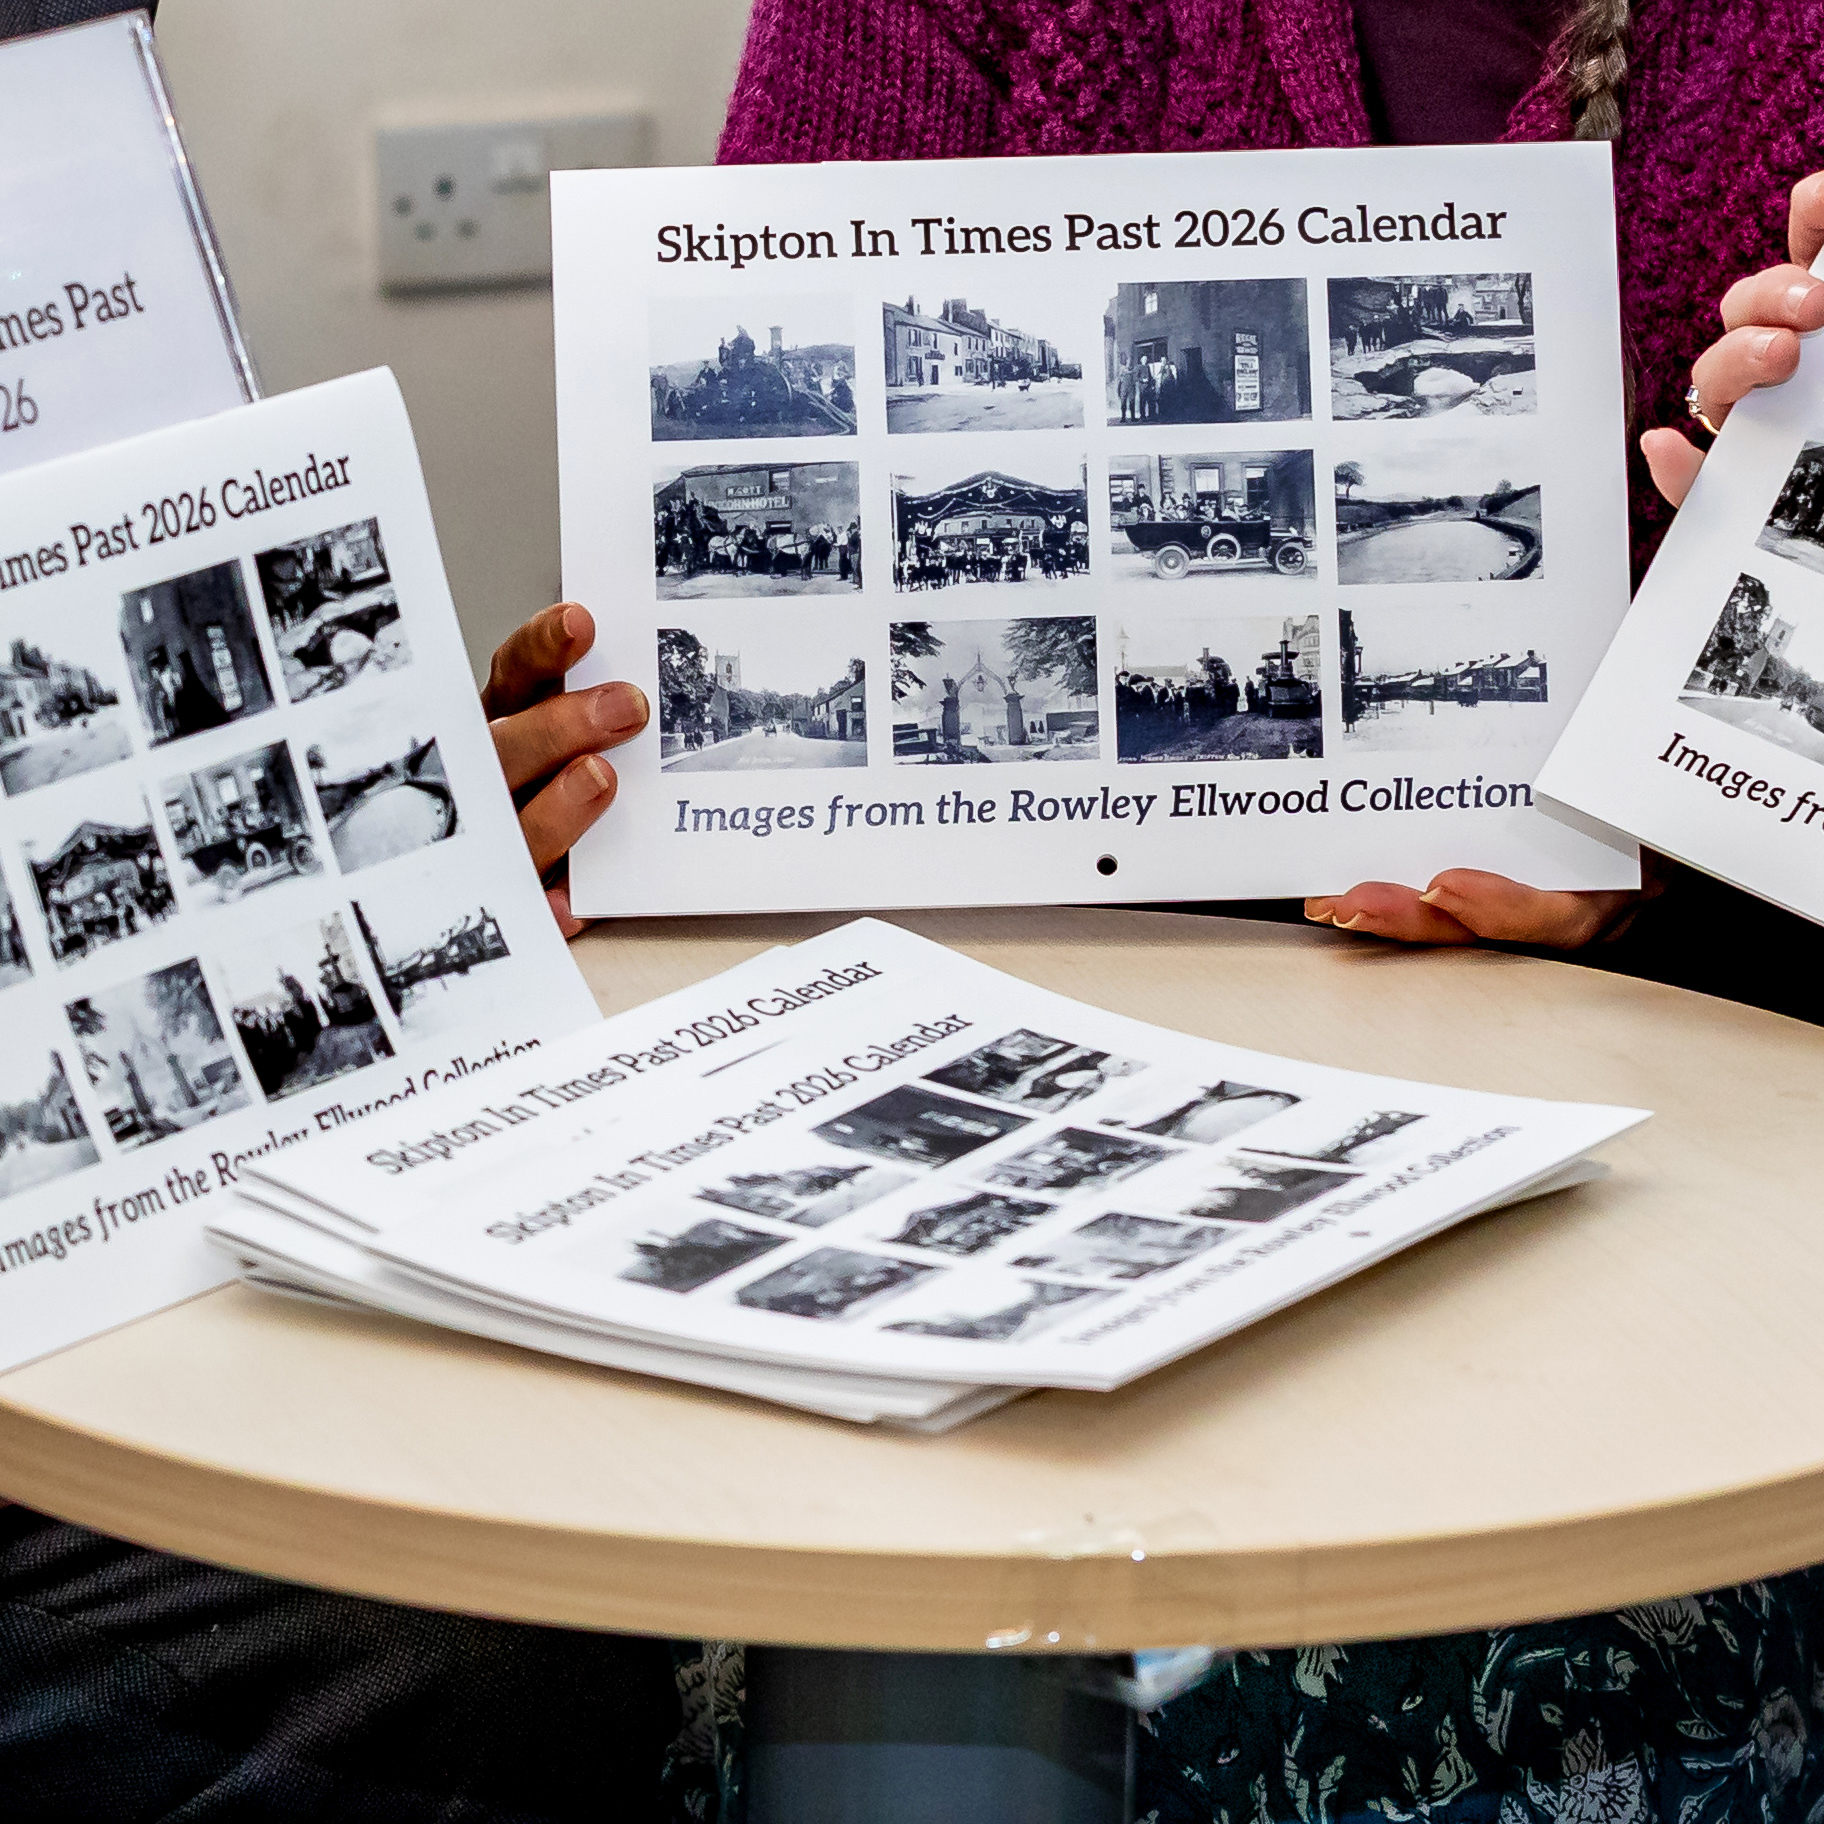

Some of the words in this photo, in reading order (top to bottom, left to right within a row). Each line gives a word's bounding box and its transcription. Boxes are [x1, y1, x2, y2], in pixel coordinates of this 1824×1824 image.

[657, 222, 839, 270] Skipton
[849, 219, 900, 258] In
[910, 216, 1053, 256] Times
[1063, 212, 1162, 252] Past
[1174, 208, 1286, 248] 2026
[1297, 201, 1508, 246] Calendar
[63, 270, 146, 332] Past
[69, 511, 141, 568] Past
[141, 485, 218, 545] 2026
[220, 452, 353, 521] Calendar
[674, 798, 815, 838] Images
[823, 794, 926, 835] from
[935, 789, 997, 825] the
[1007, 785, 1158, 826] Rowley
[1168, 779, 1330, 818] Ellwood
[1339, 774, 1534, 813] Collection
[1657, 731, 1786, 810] Images
[364, 1118, 503, 1176] Skipton
[481, 1102, 541, 1127] In
[521, 1056, 629, 1111] Times
[616, 1030, 691, 1077] Past
[675, 1003, 759, 1049] 2026
[745, 957, 885, 1018] Calendar
[483, 1187, 613, 1249] Skipton
[592, 1169, 642, 1196] In
[629, 1117, 736, 1177] Times
[721, 1096, 795, 1137] Past
[776, 1064, 860, 1107] 2026
[843, 1010, 975, 1075] Calendar
[92, 1186, 170, 1243] from
[164, 1165, 213, 1211] the
